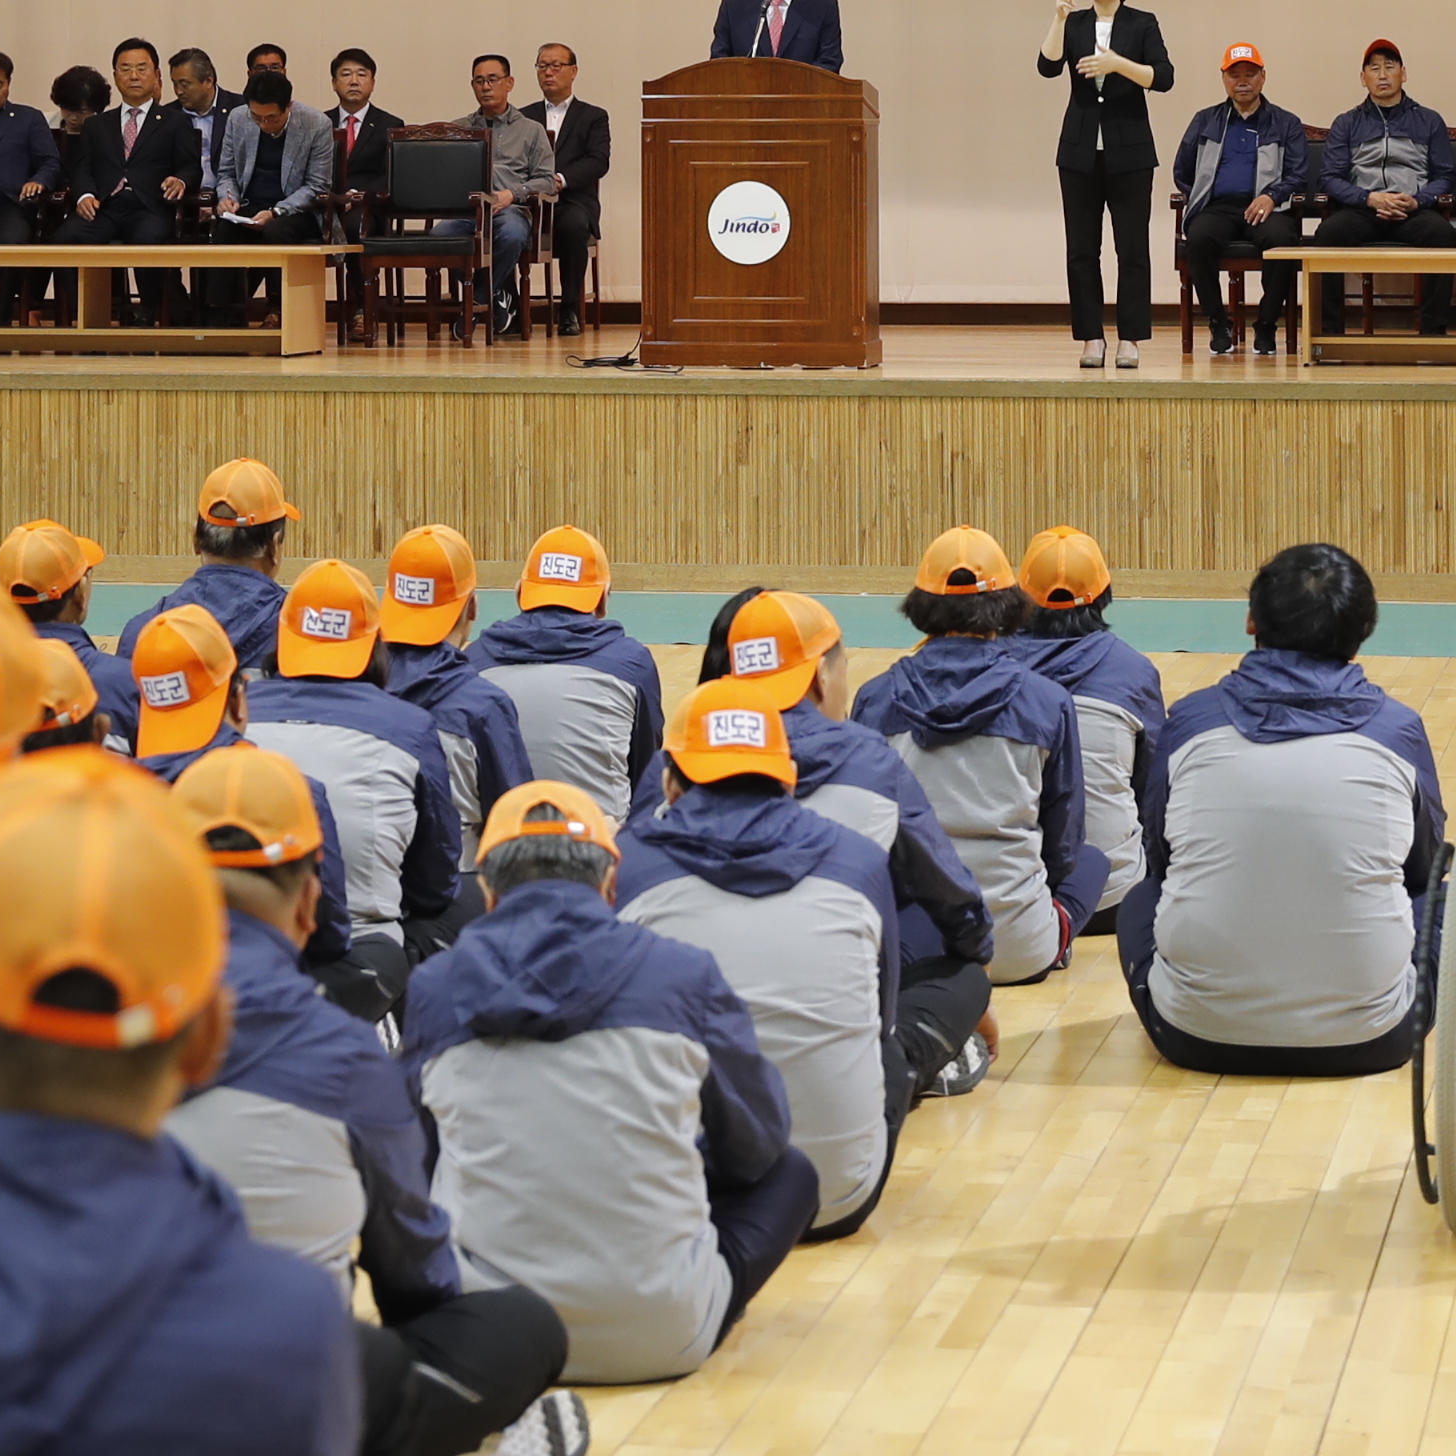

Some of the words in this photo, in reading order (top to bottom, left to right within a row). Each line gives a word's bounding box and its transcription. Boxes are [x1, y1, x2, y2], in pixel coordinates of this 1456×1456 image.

[718, 219, 769, 234] Jindo
[542, 556, 578, 578] 진도군
[396, 577, 430, 602] 진도군
[736, 641, 772, 671] 진도군
[713, 713, 761, 743] 진도군
